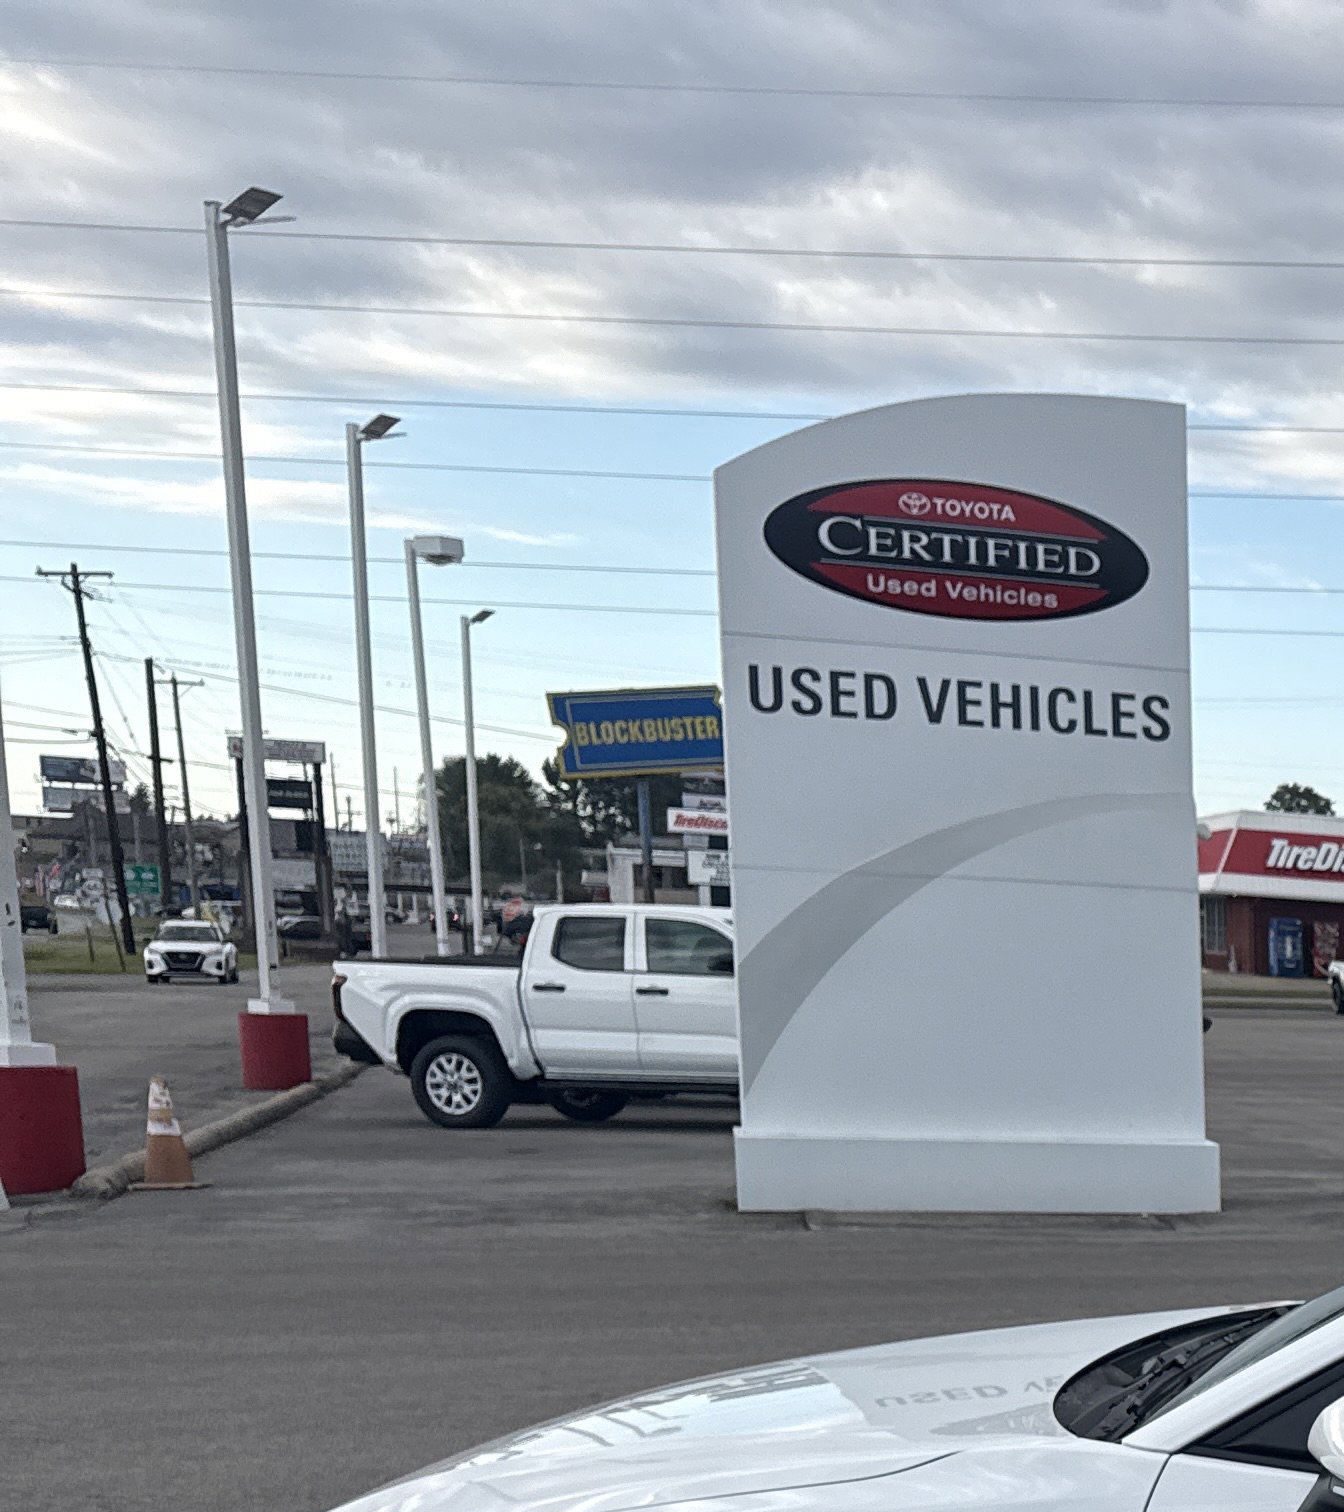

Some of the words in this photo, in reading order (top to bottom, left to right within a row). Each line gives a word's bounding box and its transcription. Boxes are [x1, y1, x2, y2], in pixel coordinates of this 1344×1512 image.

[932, 497, 1016, 521] TOYOTA
[818, 516, 1101, 577] CERTIFIED
[867, 573, 937, 598] Used
[944, 580, 1059, 610] Vehicles
[748, 664, 898, 722] USED
[916, 676, 1171, 742] VEHICLES
[574, 715, 719, 747] BLOCKBUSTER
